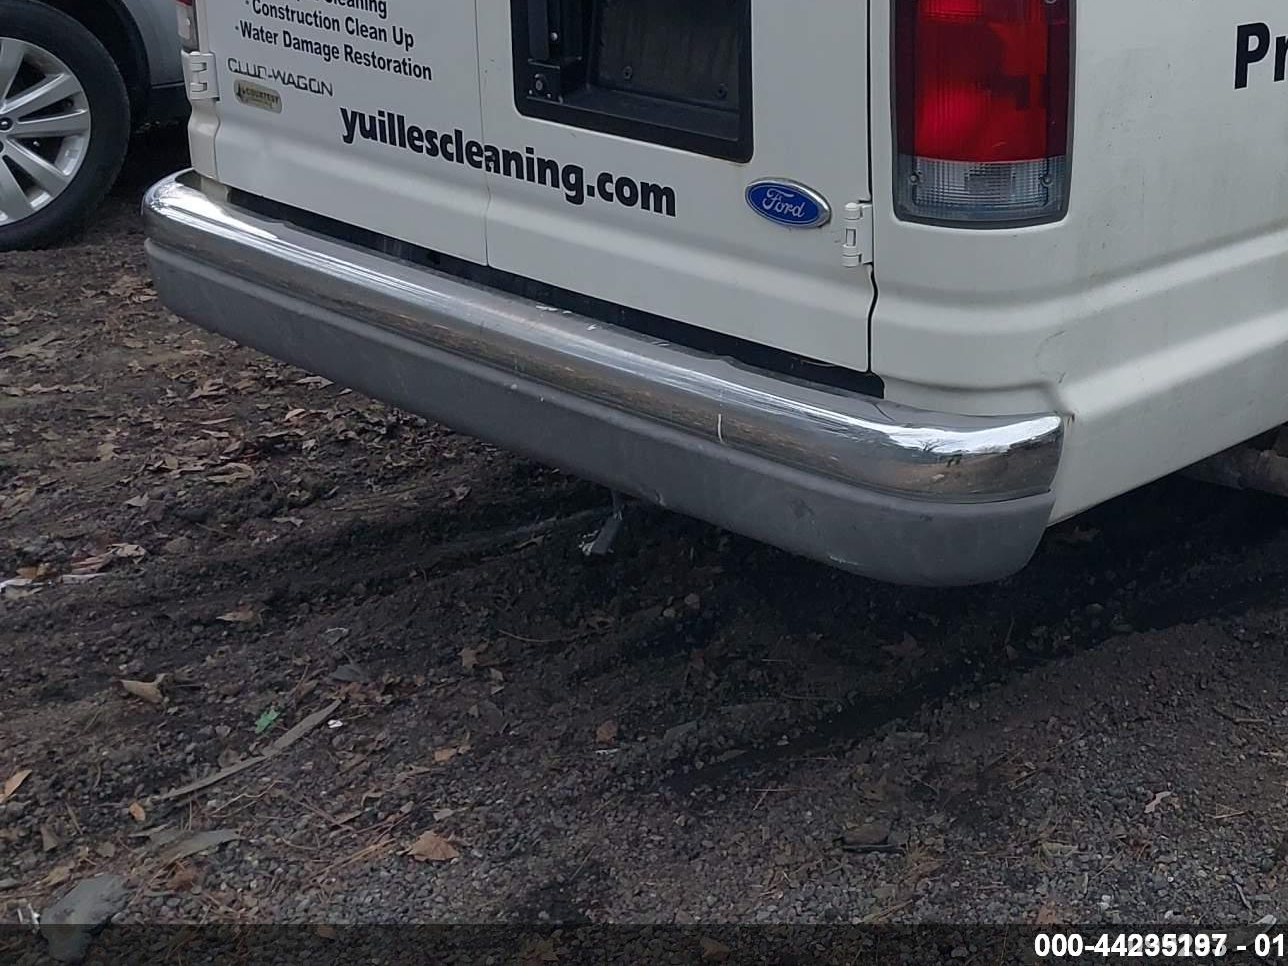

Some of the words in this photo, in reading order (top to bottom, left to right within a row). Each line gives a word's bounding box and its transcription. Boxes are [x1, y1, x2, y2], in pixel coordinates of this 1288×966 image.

[240, 20, 278, 45] Water
[283, 30, 340, 62] Damage
[344, 44, 432, 80] Restoration
[345, 16, 387, 43] Clean
[392, 26, 414, 51] Up
[340, 107, 676, 218] yuillescleaning.com
[762, 188, 805, 218] Ford
